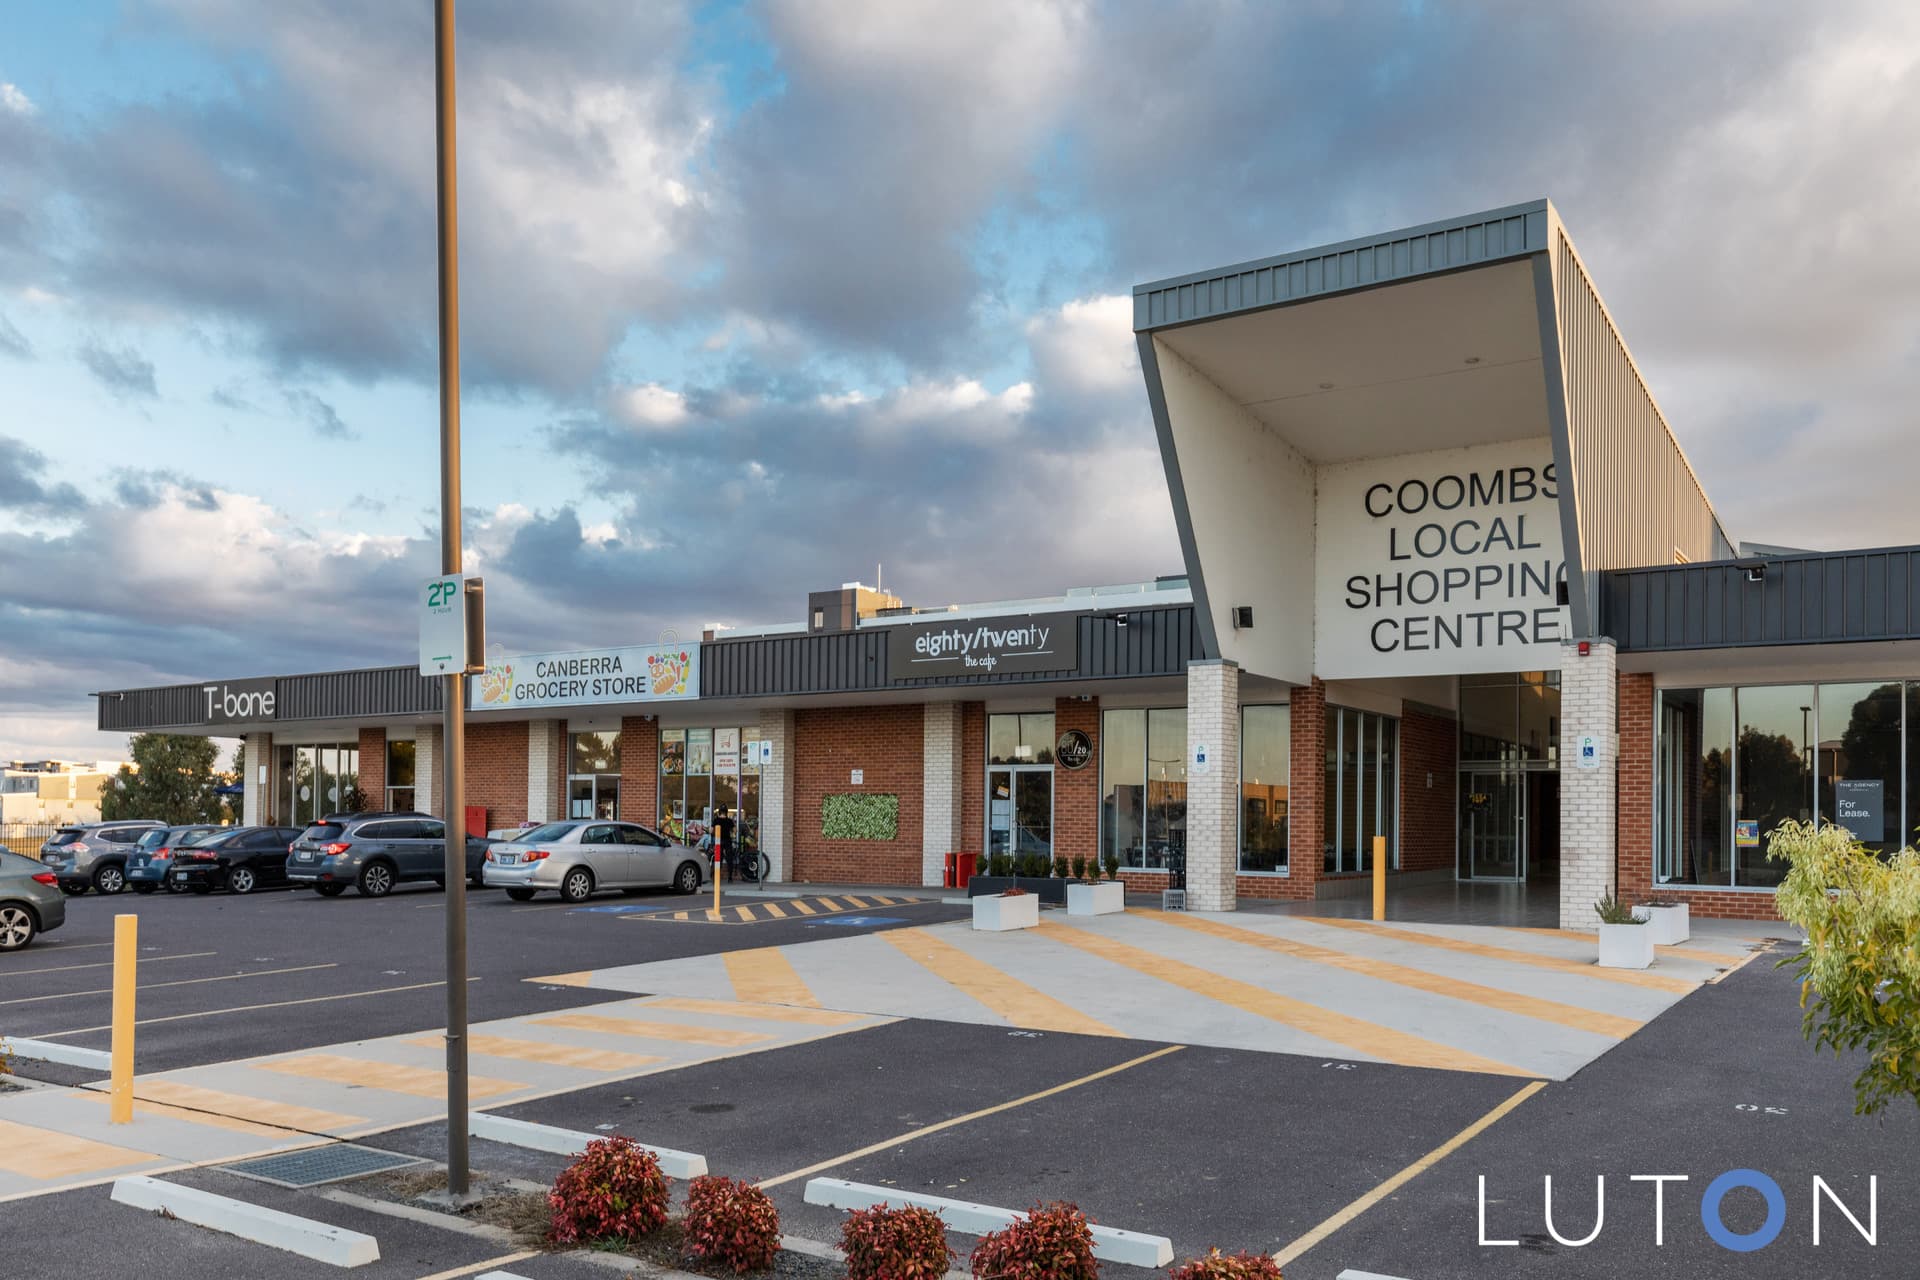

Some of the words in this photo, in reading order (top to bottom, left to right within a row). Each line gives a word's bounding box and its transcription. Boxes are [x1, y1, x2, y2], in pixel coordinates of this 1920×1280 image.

[1365, 463, 1559, 518] COOMBS
[1390, 515, 1541, 561] LOCAL
[428, 582, 456, 607] 2P
[1345, 560, 1568, 609] SHOPPIN
[915, 624, 1049, 656] eighty/twenty
[1371, 608, 1561, 652] CENTRE
[536, 656, 622, 678] CANBERRA
[965, 655, 978, 667] the
[979, 653, 997, 671] cafe
[203, 685, 275, 719] T-bone
[515, 680, 588, 700] GROCERY
[592, 676, 647, 696] STORE
[1839, 800, 1856, 808] For
[1839, 809, 1870, 817] Lease.
